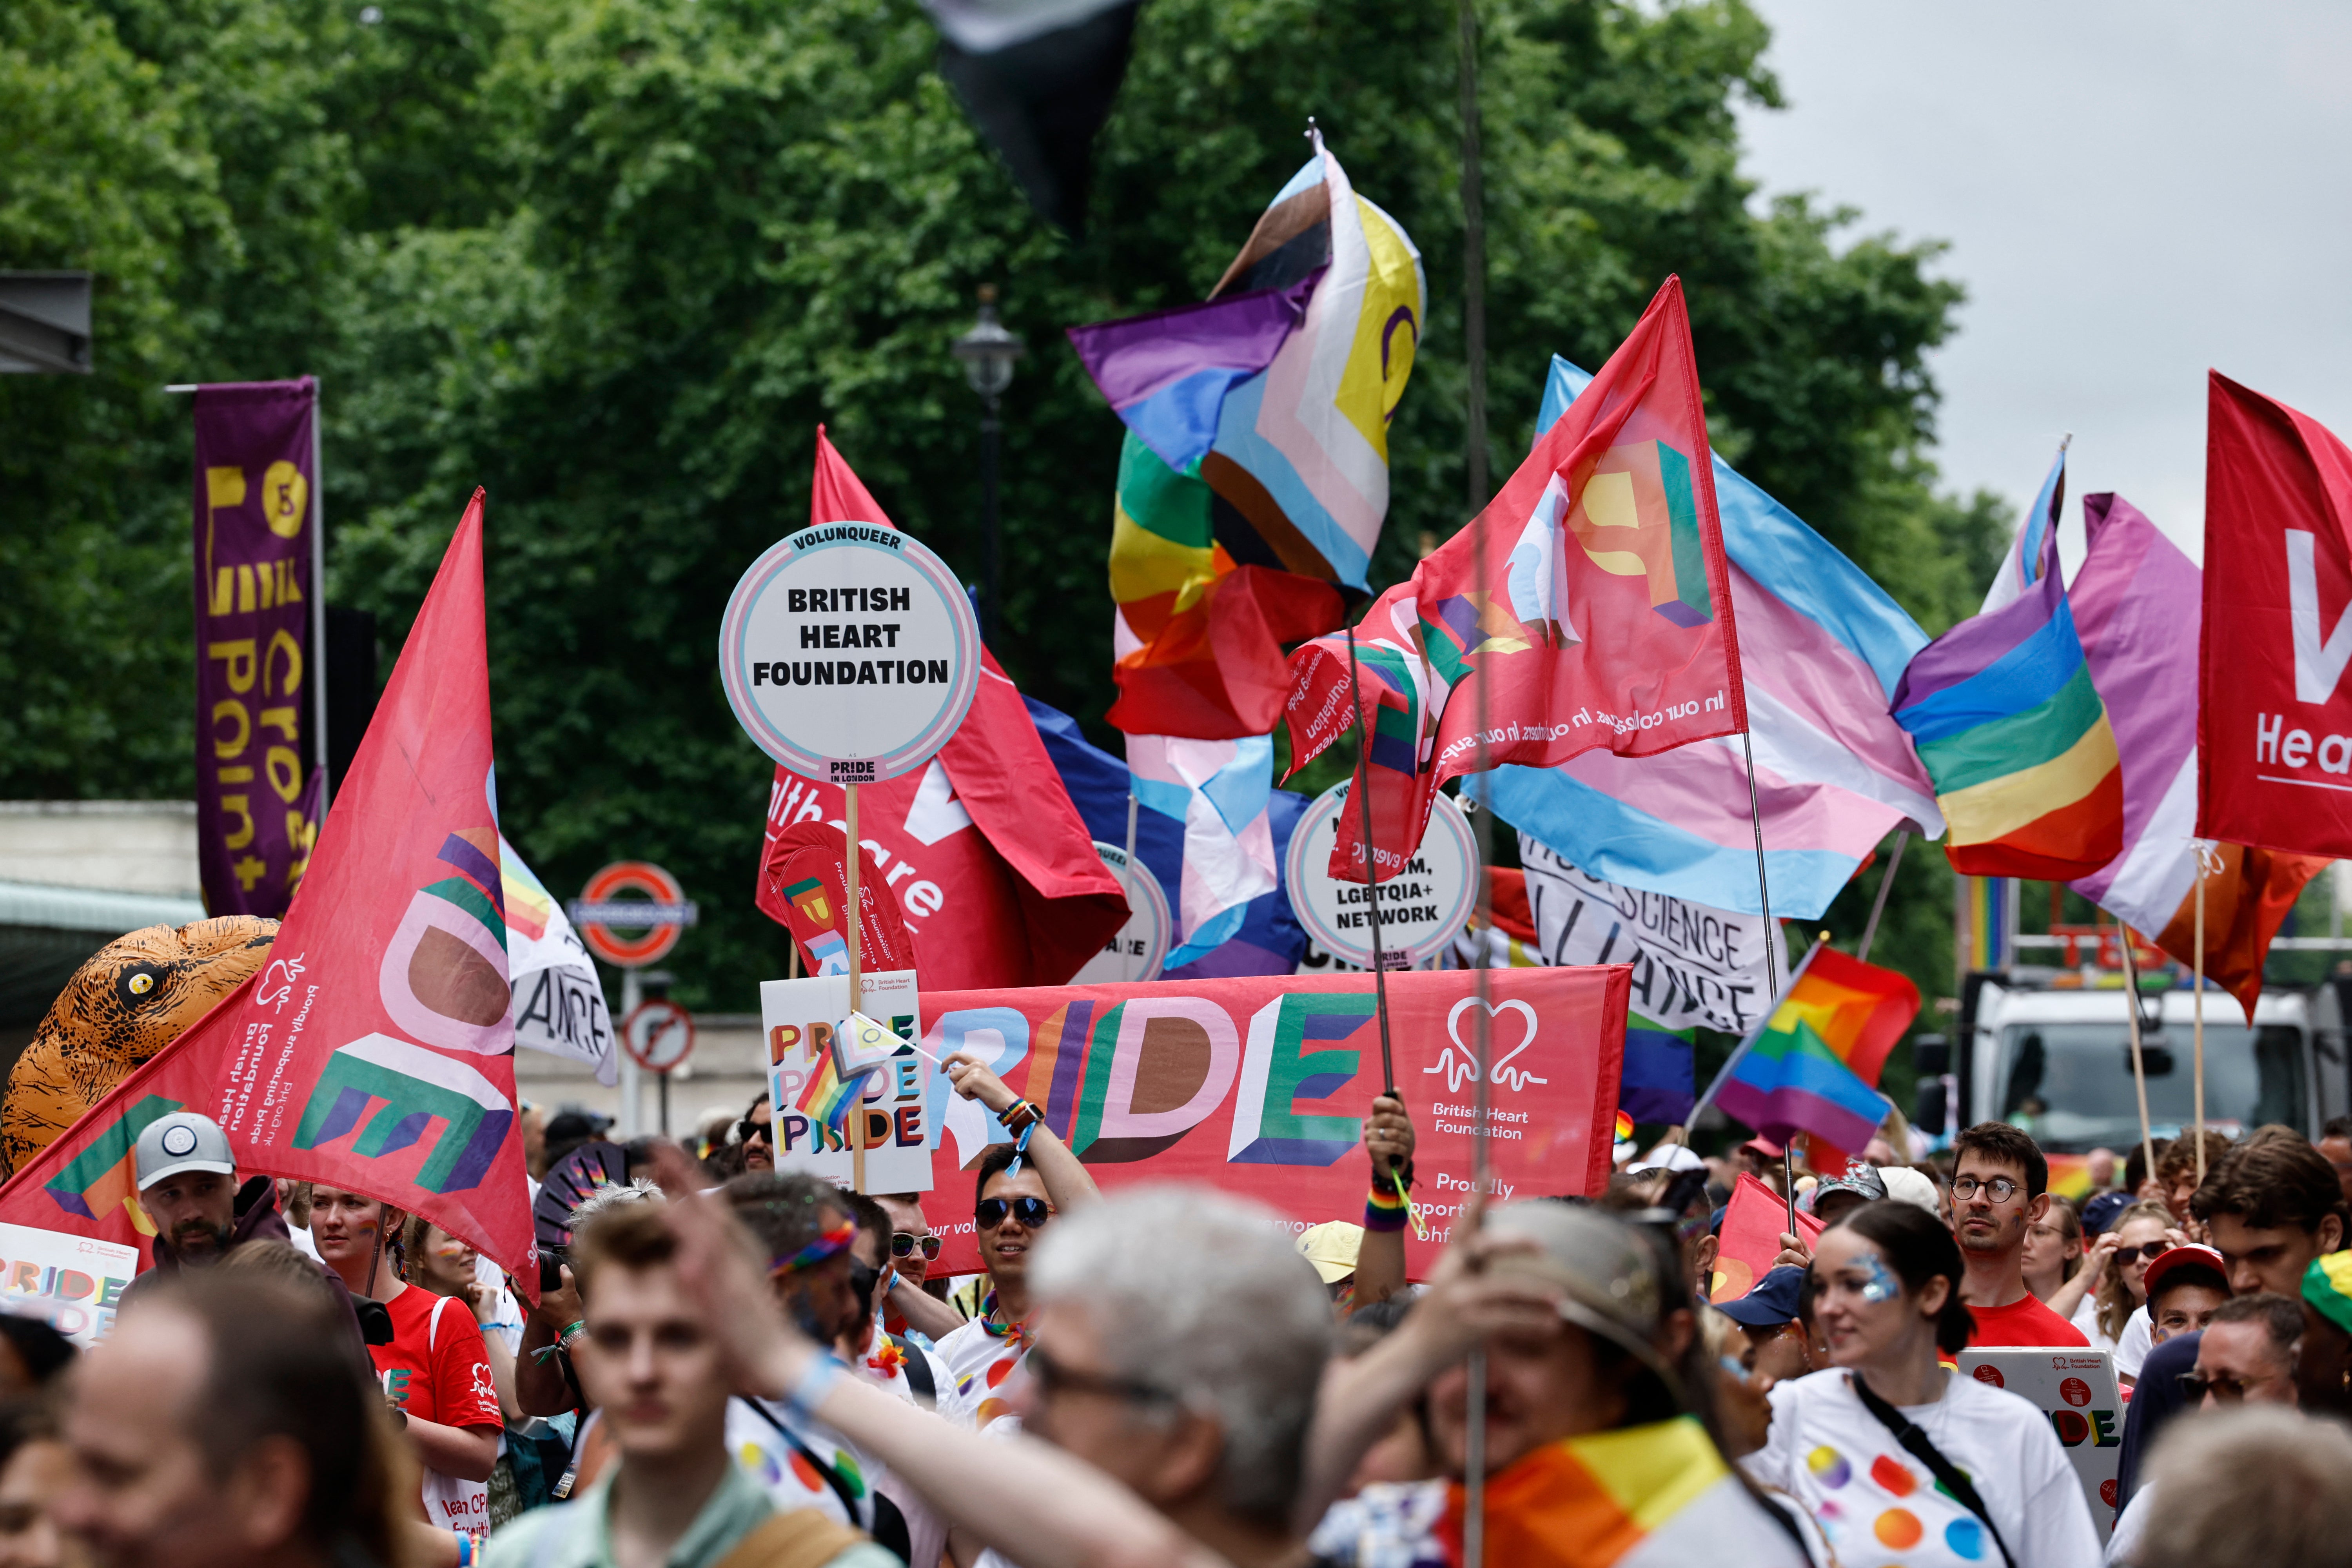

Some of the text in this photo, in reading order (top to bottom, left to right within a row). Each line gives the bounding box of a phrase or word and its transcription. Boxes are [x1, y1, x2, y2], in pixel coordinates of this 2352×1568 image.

[793, 527, 901, 550] VOLUNQUEER
[788, 588, 910, 612] BRITISH
[800, 624, 900, 649] HEART
[753, 660, 948, 686] FOUNDATION
[1337, 882, 1433, 905] LGBTQIA+
[1337, 905, 1439, 929] NETWORK
[1433, 1102, 1528, 1124] British Heart
[1435, 1119, 1522, 1140] Foundation
[1436, 1172, 1514, 1201] Proudly
